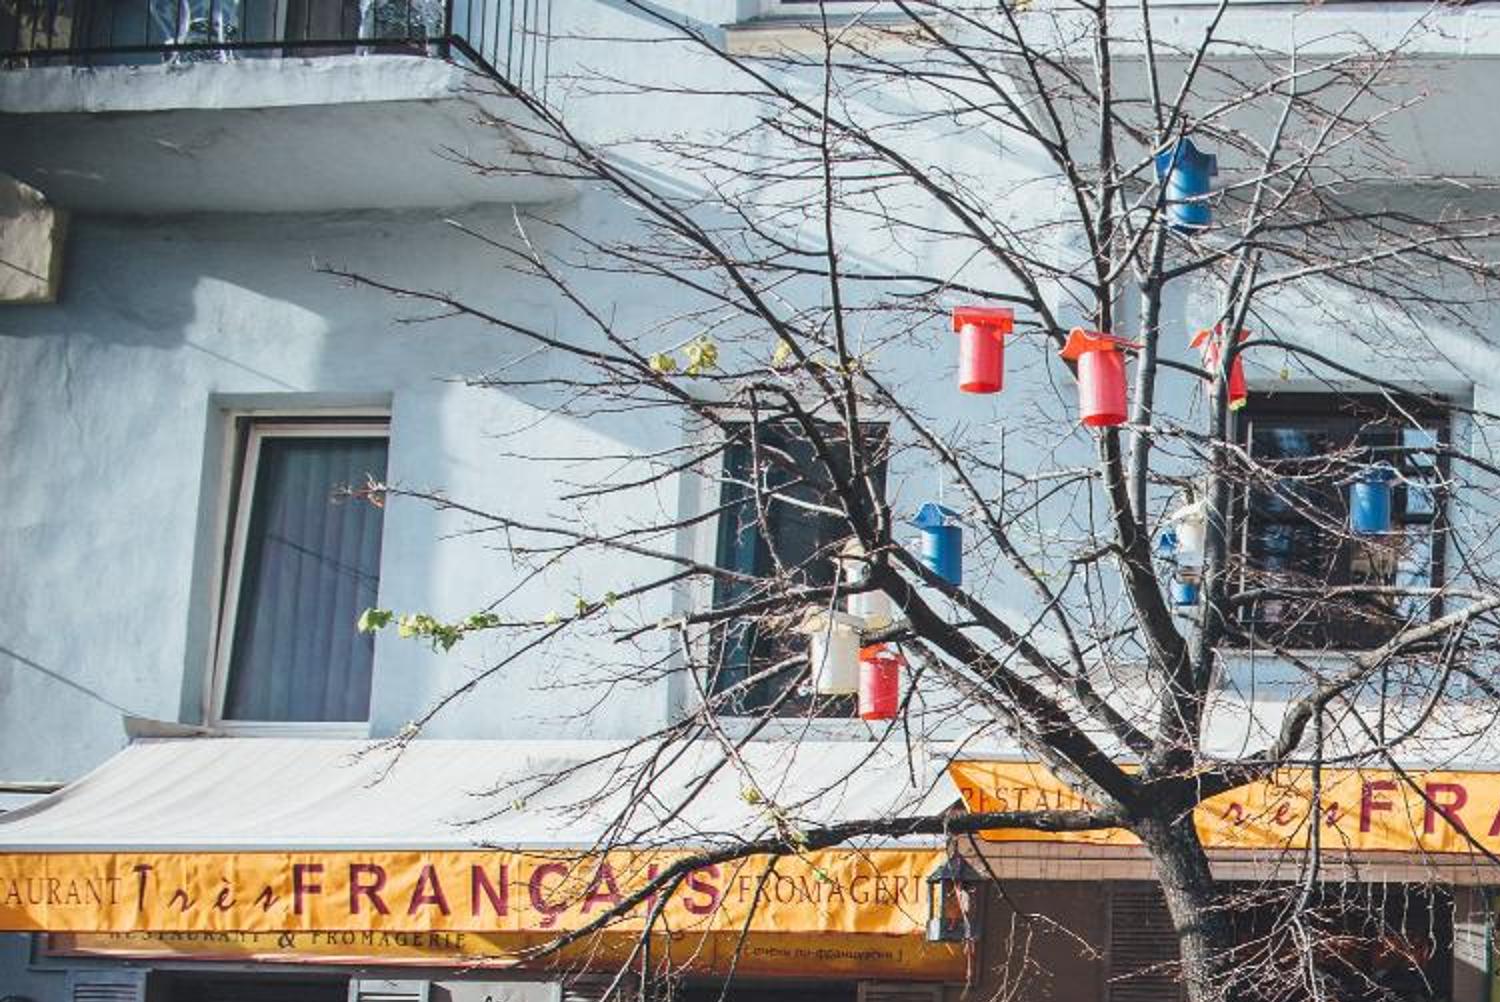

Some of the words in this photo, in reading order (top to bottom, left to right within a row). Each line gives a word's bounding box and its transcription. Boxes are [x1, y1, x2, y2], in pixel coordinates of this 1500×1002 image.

[0, 877, 122, 905] AURANT
[133, 863, 281, 913] Très
[291, 862, 722, 928] FRANÇAIS
[738, 874, 923, 905] FROMAGERI
[278, 932, 297, 949] &
[310, 931, 466, 950] FROMAGERIE
